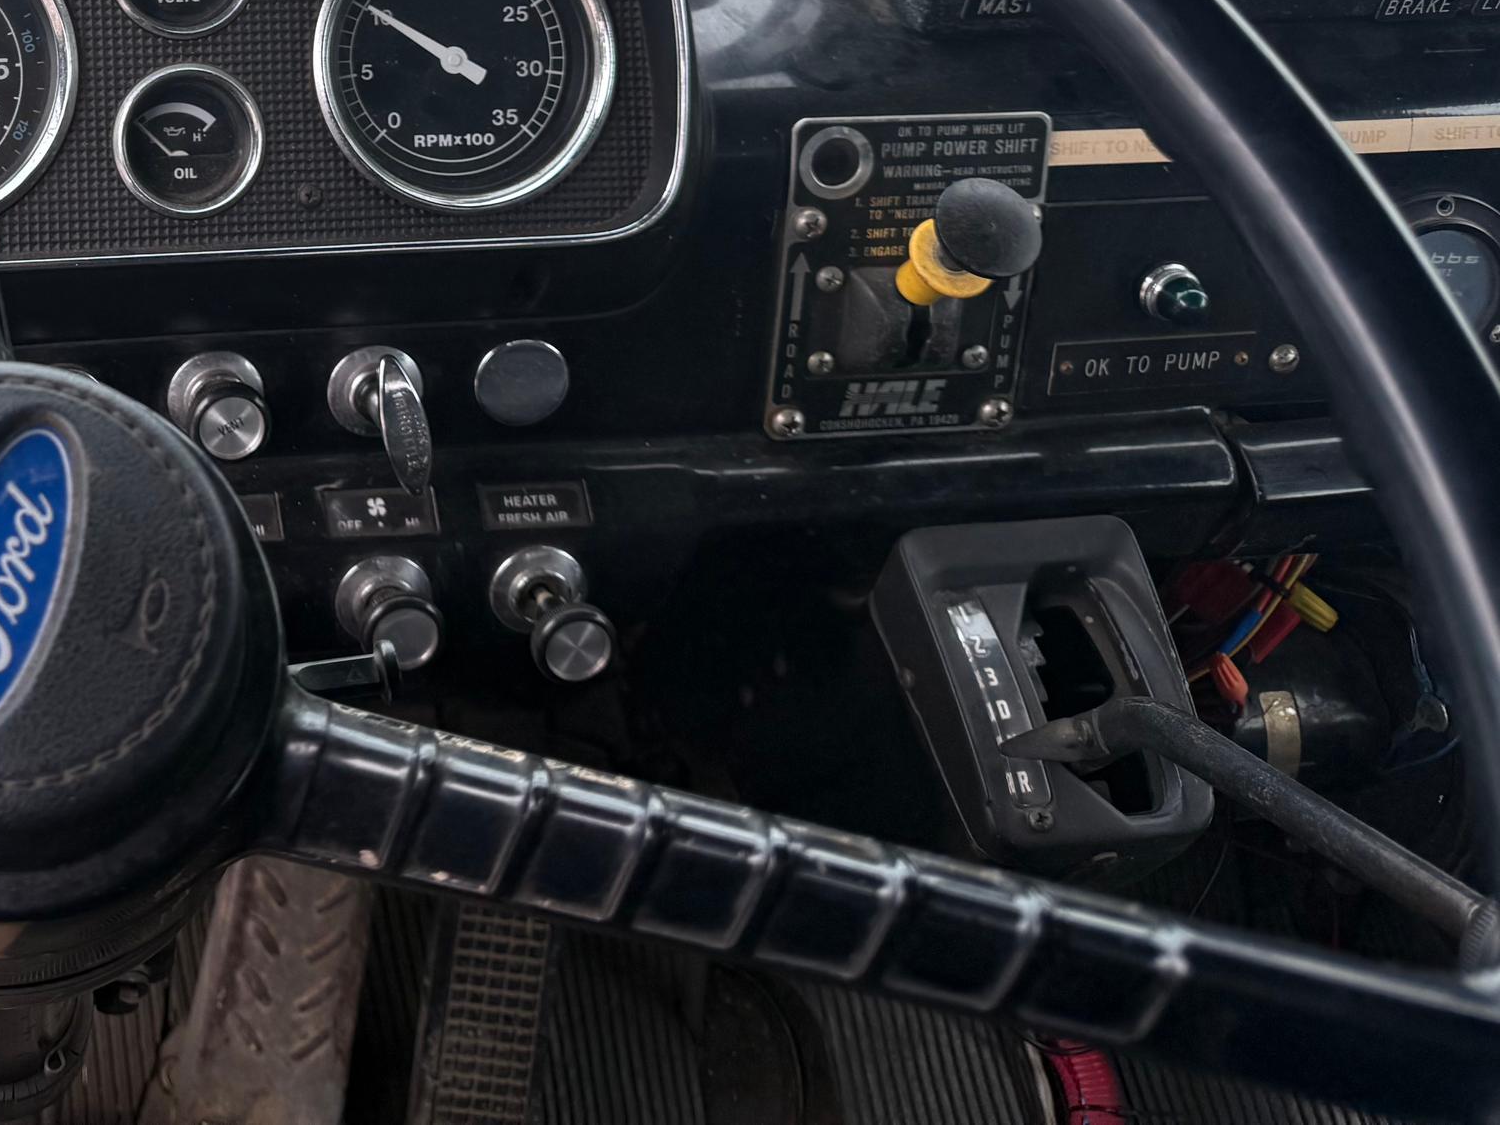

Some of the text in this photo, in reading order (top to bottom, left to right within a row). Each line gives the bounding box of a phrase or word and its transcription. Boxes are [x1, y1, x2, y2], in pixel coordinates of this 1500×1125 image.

[503, 6, 529, 22] 25
[20, 29, 36, 53] 100
[361, 64, 374, 81] 5
[516, 60, 543, 77] 30
[387, 112, 401, 129] 0
[492, 109, 519, 126] 35
[12, 118, 29, 141] 120
[193, 133, 202, 143] H
[918, 126, 932, 137] TO
[936, 125, 968, 136] PUMP
[972, 124, 1004, 135] WHEN
[1007, 123, 1026, 134] LIT
[413, 133, 495, 148] RPMx100
[881, 138, 1039, 158] PUMP POWER SHIFT
[173, 167, 198, 180] OIL
[868, 196, 901, 207] SHIFT
[869, 209, 883, 220] TO
[866, 227, 897, 239] SHIFT
[863, 245, 906, 257] ENGAGE
[1084, 350, 1221, 377] OK TO PUMP
[838, 379, 948, 417] HALE
[216, 417, 245, 436] VENT
[503, 493, 558, 508] HEATER
[498, 510, 570, 523] FRESH AIR
[969, 635, 987, 655] 2
[984, 667, 999, 686] 3
[996, 700, 1011, 720] D
[1016, 770, 1031, 793] R
